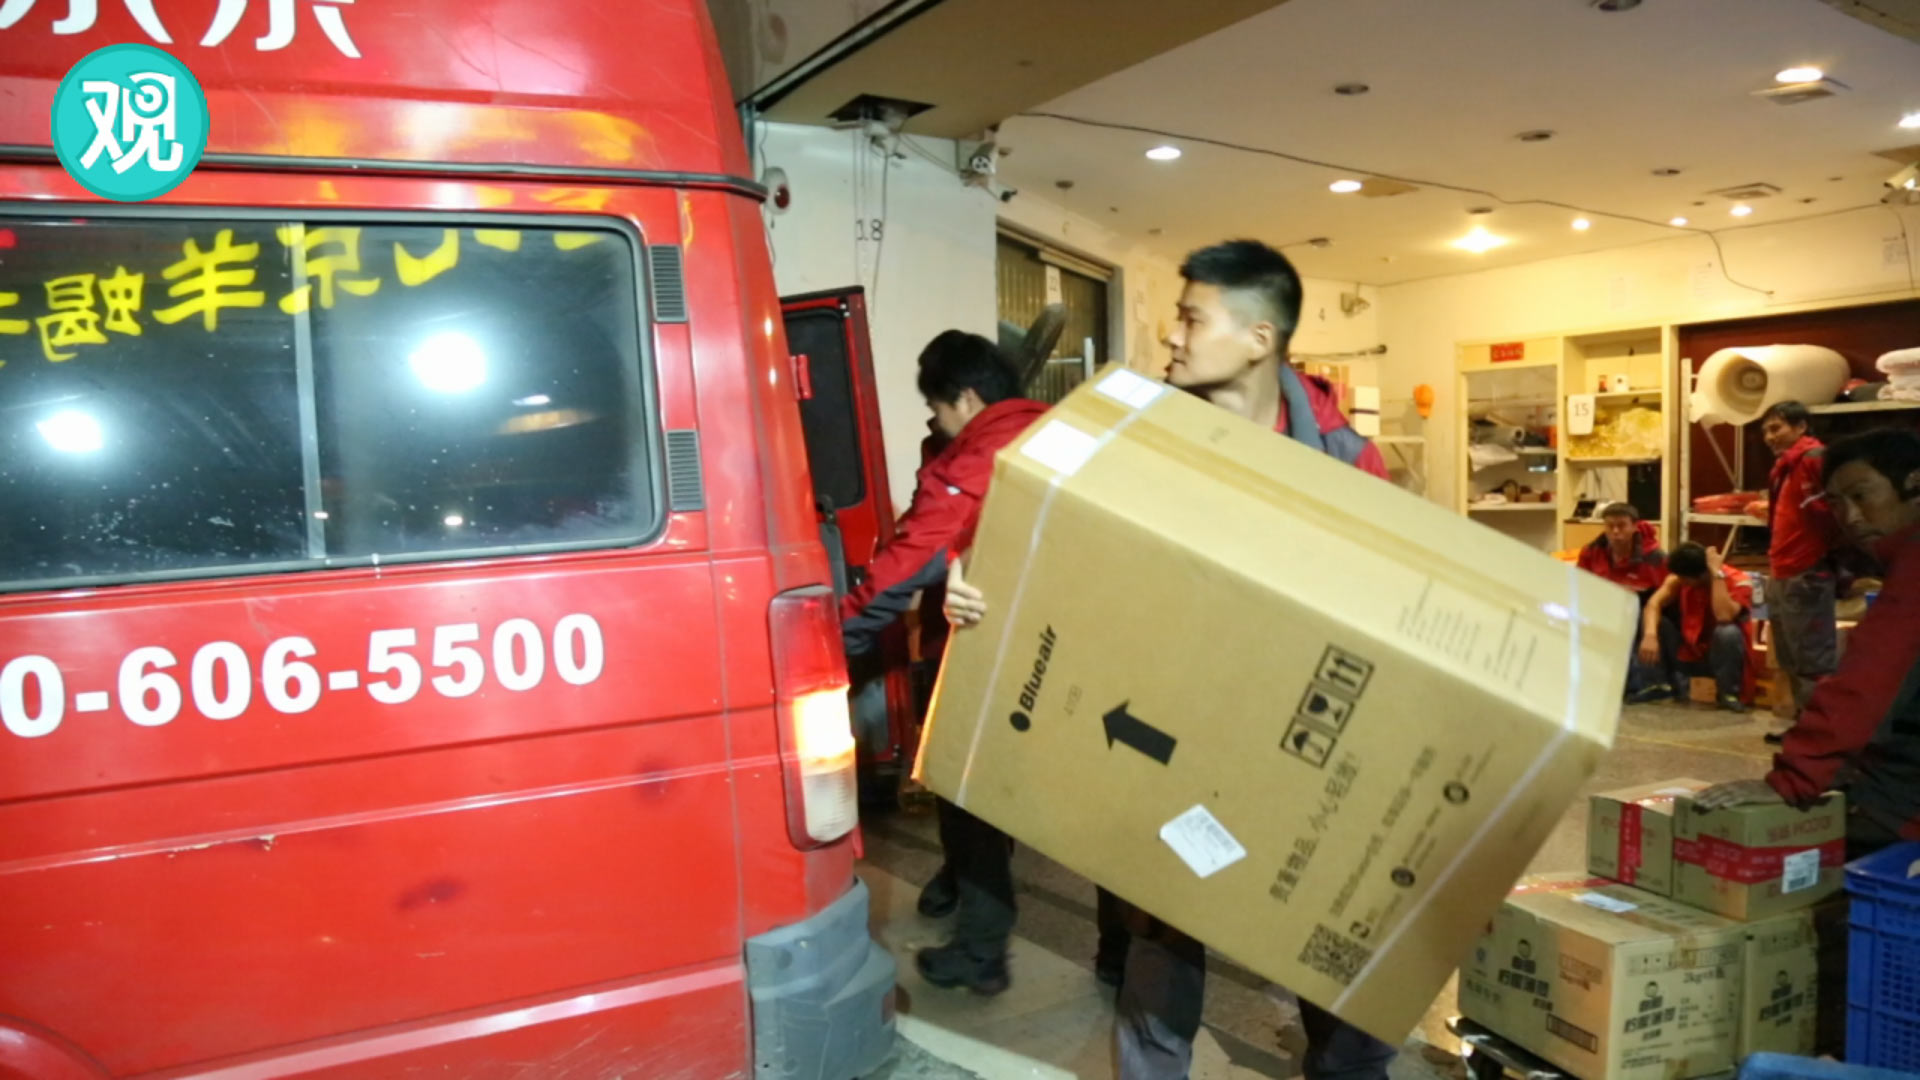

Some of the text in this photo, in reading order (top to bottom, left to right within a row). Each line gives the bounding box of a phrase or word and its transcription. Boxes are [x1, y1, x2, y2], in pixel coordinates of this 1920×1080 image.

[1574, 402, 1590, 418] 15
[0, 613, 604, 738] 0-606-5500
[1018, 623, 1058, 713] Blueair
